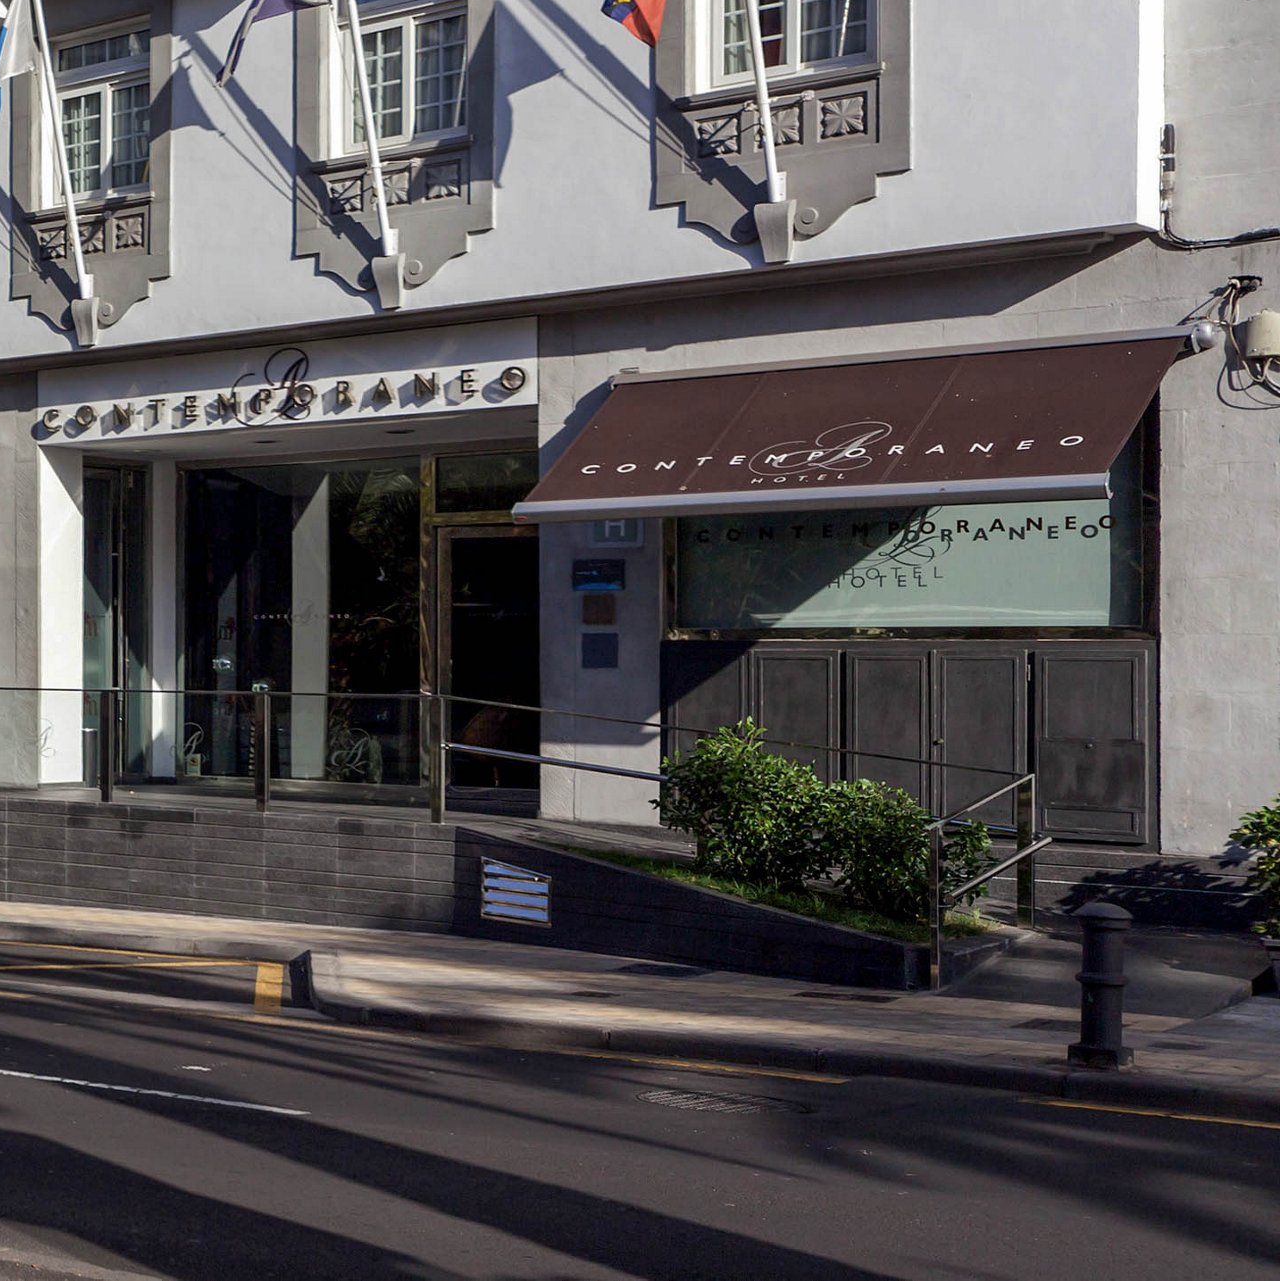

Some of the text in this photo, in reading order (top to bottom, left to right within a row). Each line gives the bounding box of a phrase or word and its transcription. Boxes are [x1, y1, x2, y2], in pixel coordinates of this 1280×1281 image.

[42, 365, 526, 432] CONTEMPORANEO
[581, 435, 1085, 475] CONTEMPORANEO
[750, 473, 846, 484] HOTEL
